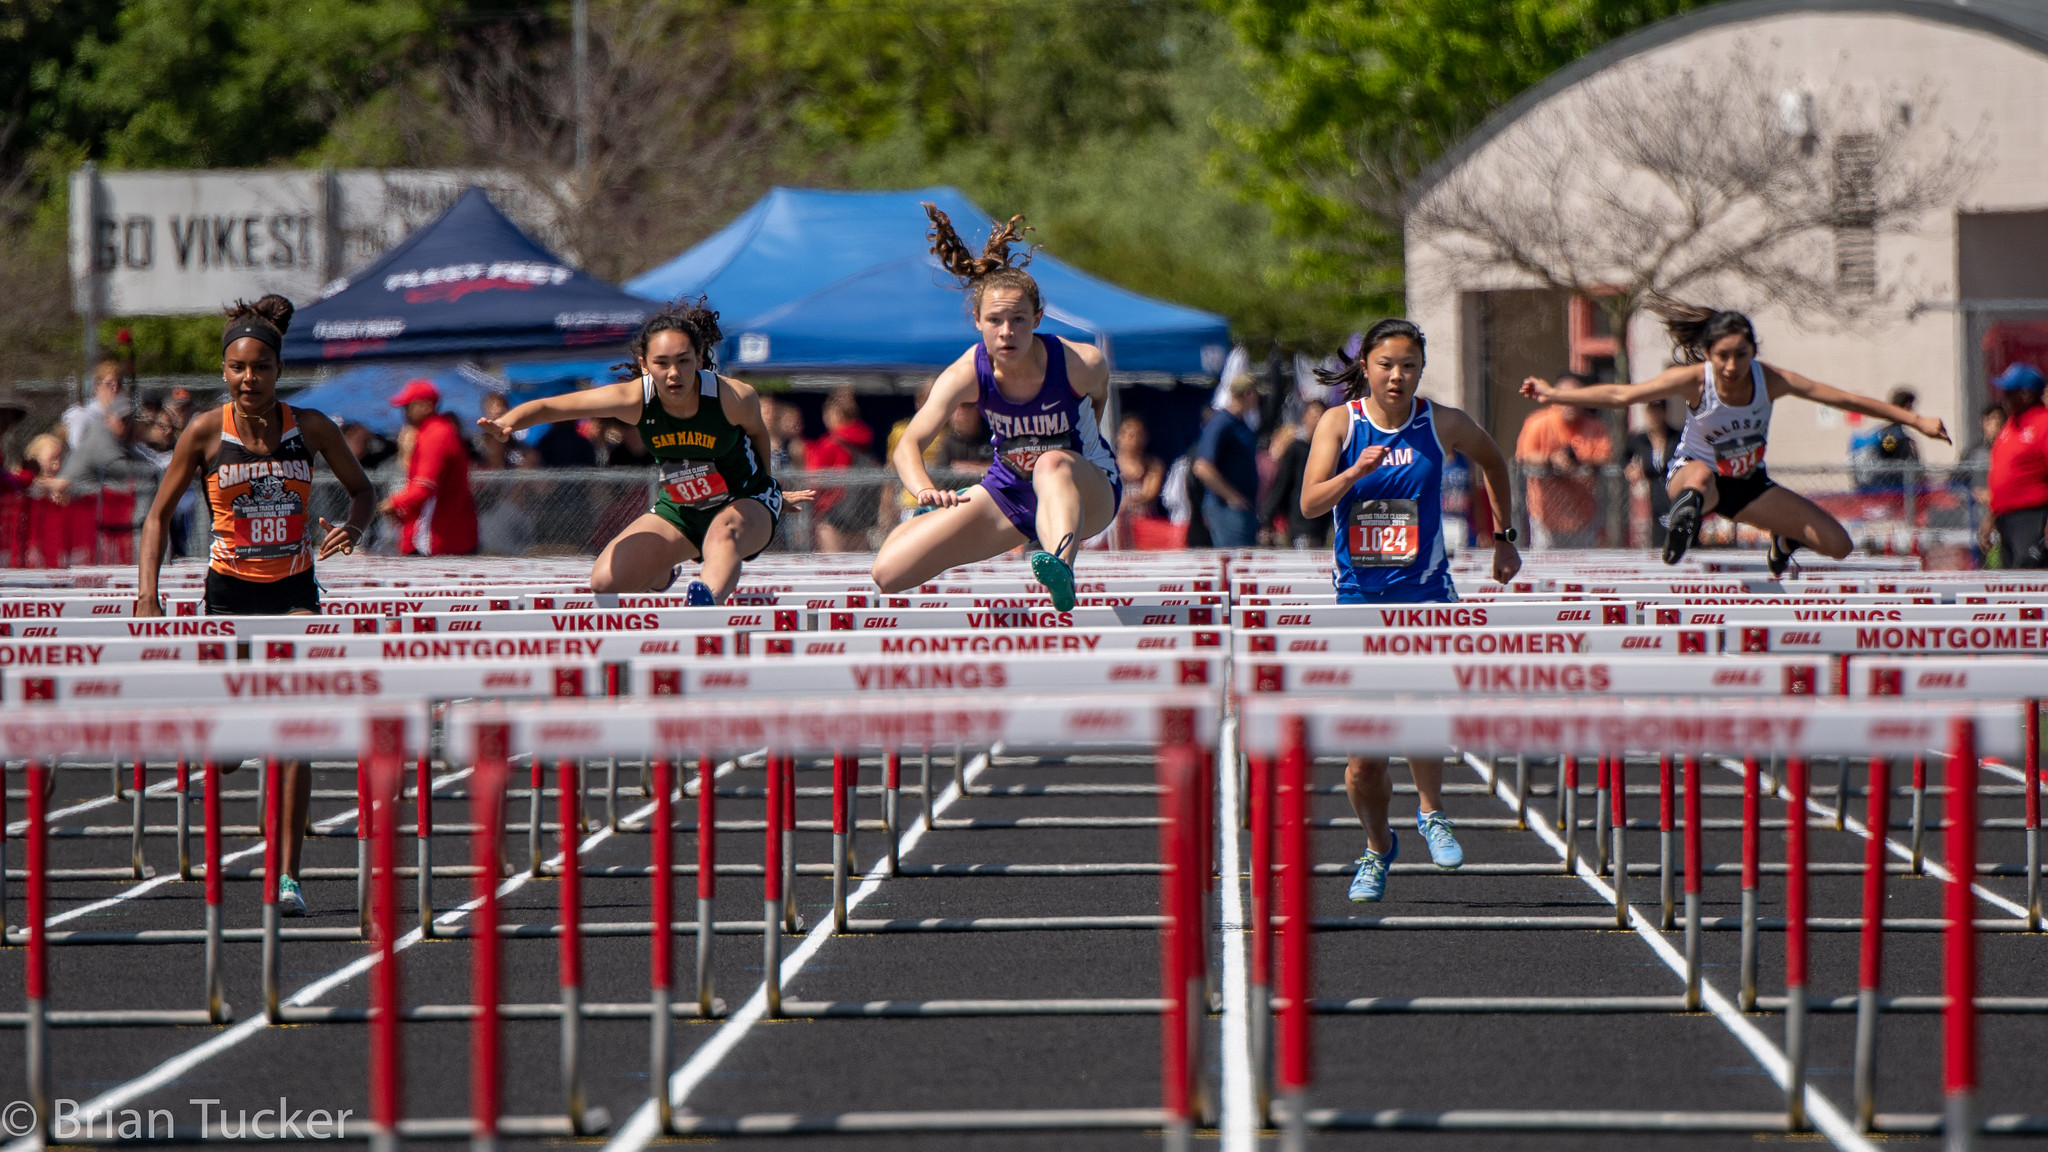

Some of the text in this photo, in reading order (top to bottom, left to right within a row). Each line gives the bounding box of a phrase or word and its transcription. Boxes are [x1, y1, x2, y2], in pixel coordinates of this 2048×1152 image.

[984, 408, 1070, 438] PETALUMA
[651, 431, 717, 449] SAN MARIN
[1382, 448, 1413, 466] AM
[218, 459, 311, 489] SANTA ROSA
[676, 478, 712, 500] 813
[251, 518, 287, 543] 836
[1359, 527, 1407, 552] 1024
[92, 604, 122, 615] GILL
[320, 601, 424, 618] TGOMERY
[563, 601, 594, 609] GILL
[806, 599, 836, 609] GILL
[448, 613, 762, 631] GILL VIKINGS GILL
[864, 612, 1177, 628] GILL VIKINGS GILL
[1276, 608, 1592, 627] GILL VIKINGS GILL
[1690, 614, 1726, 624] GILL
[1793, 609, 1902, 622] VIKINGS
[22, 620, 341, 637] GILL VIKINGS GILL
[1779, 631, 1823, 646] GILL
[382, 638, 604, 660] MONTGOMERY
[639, 640, 680, 653] GILL
[880, 635, 1101, 656] MONTGOMERY
[1288, 633, 1664, 656] GILL MONTGOMERY GILL
[223, 669, 383, 698] VIKINGS
[851, 661, 1008, 691] VIKINGS
[1452, 663, 1612, 693] VIKINGS
